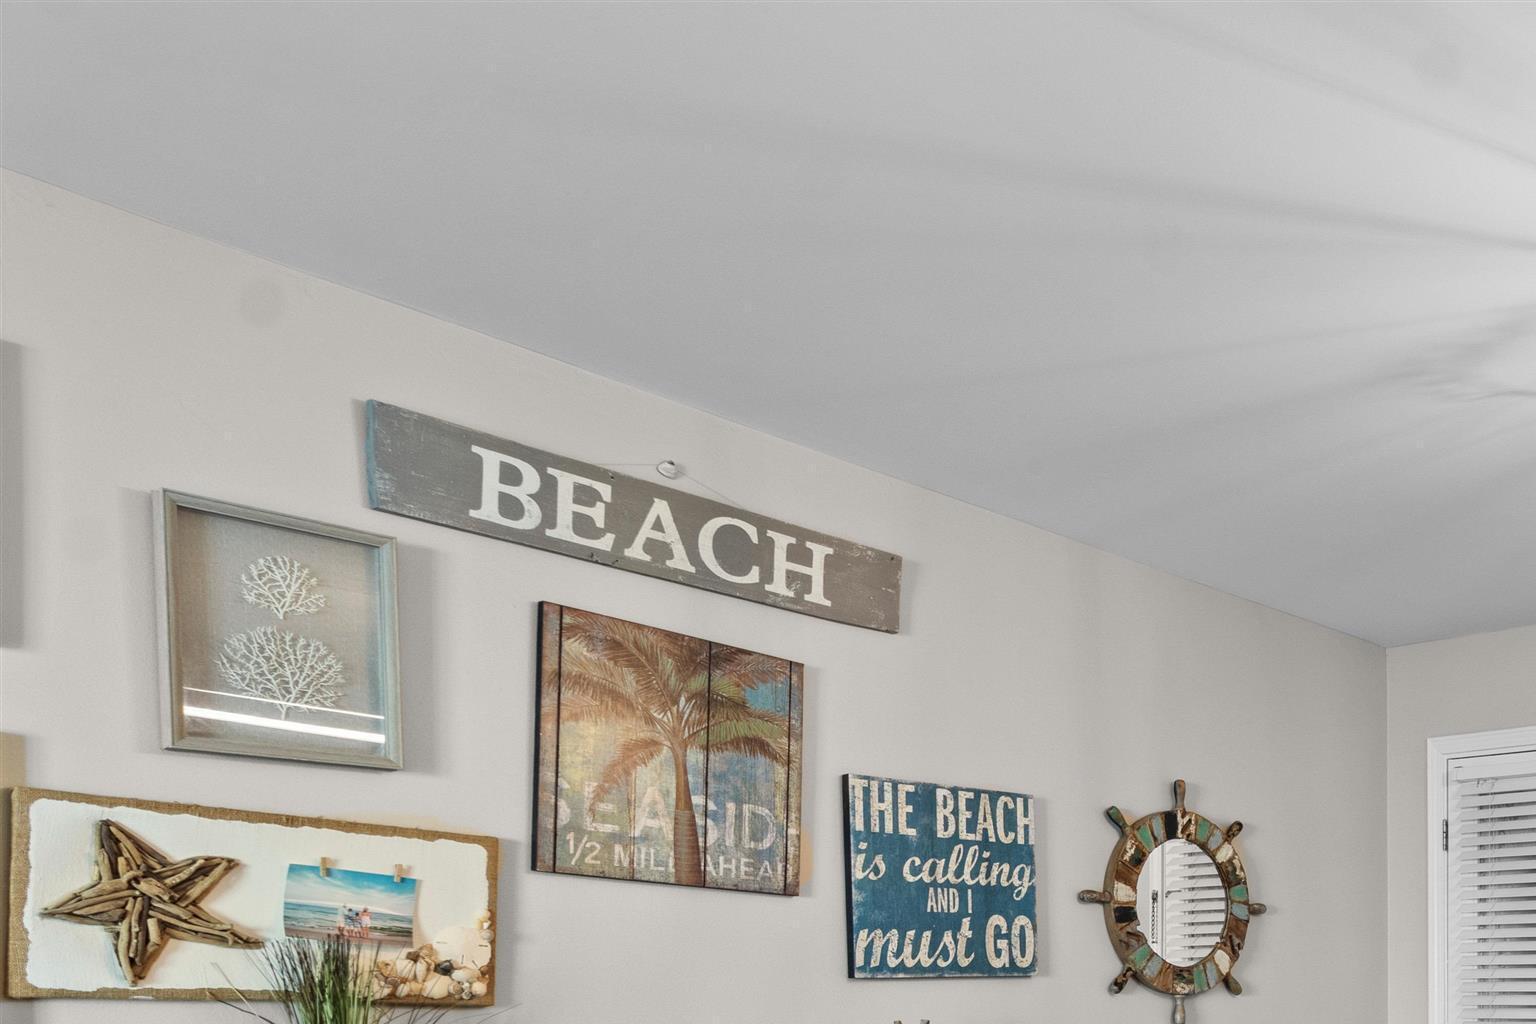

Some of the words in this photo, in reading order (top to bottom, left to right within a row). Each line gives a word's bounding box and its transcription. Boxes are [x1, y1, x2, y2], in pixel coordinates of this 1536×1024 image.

[469, 445, 834, 606] BEACH
[848, 778, 916, 836] THE
[935, 787, 1035, 845] BEACH
[566, 831, 601, 866] 1/2
[854, 842, 886, 880] is
[902, 844, 1036, 901] calling
[927, 887, 959, 913] AND
[967, 888, 973, 914] I
[855, 917, 975, 968] must
[985, 914, 1035, 969] GO
